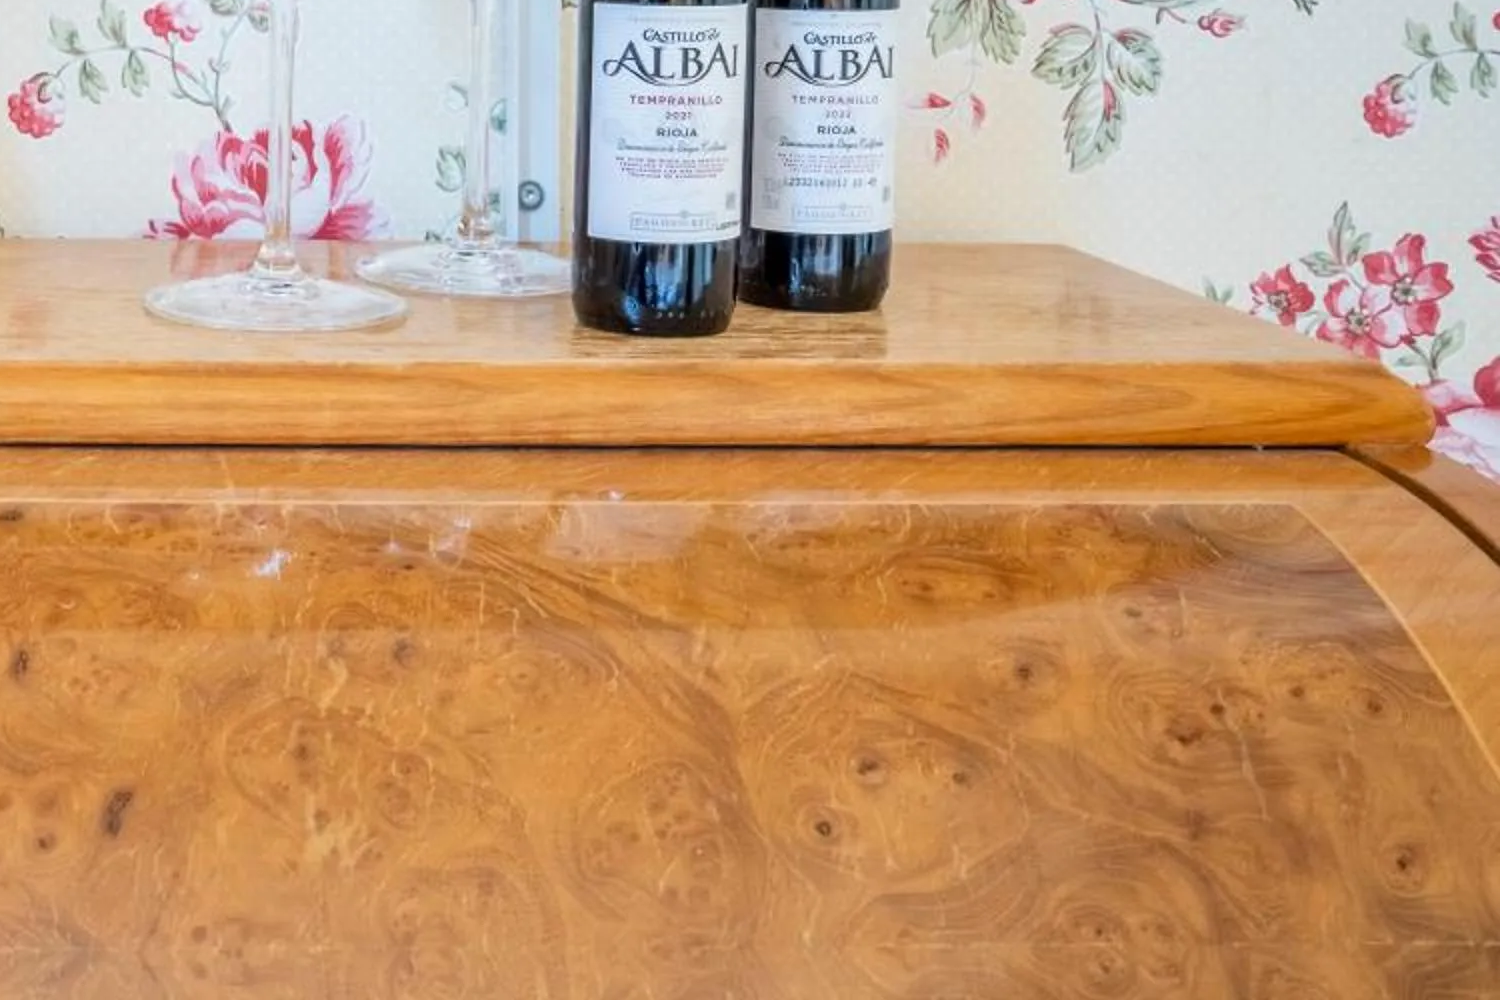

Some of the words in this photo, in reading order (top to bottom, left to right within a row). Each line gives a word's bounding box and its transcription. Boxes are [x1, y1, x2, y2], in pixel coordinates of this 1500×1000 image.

[642, 27, 705, 44] CASTILLO
[803, 31, 862, 46] CASTILLO
[602, 39, 739, 87] ALBAI
[764, 43, 895, 87] ALBAI
[629, 95, 723, 105] TEMPRANILLO
[791, 95, 880, 105] TEMPRANILLO
[656, 127, 698, 137] RIOJA
[817, 125, 857, 135] RIOJA
